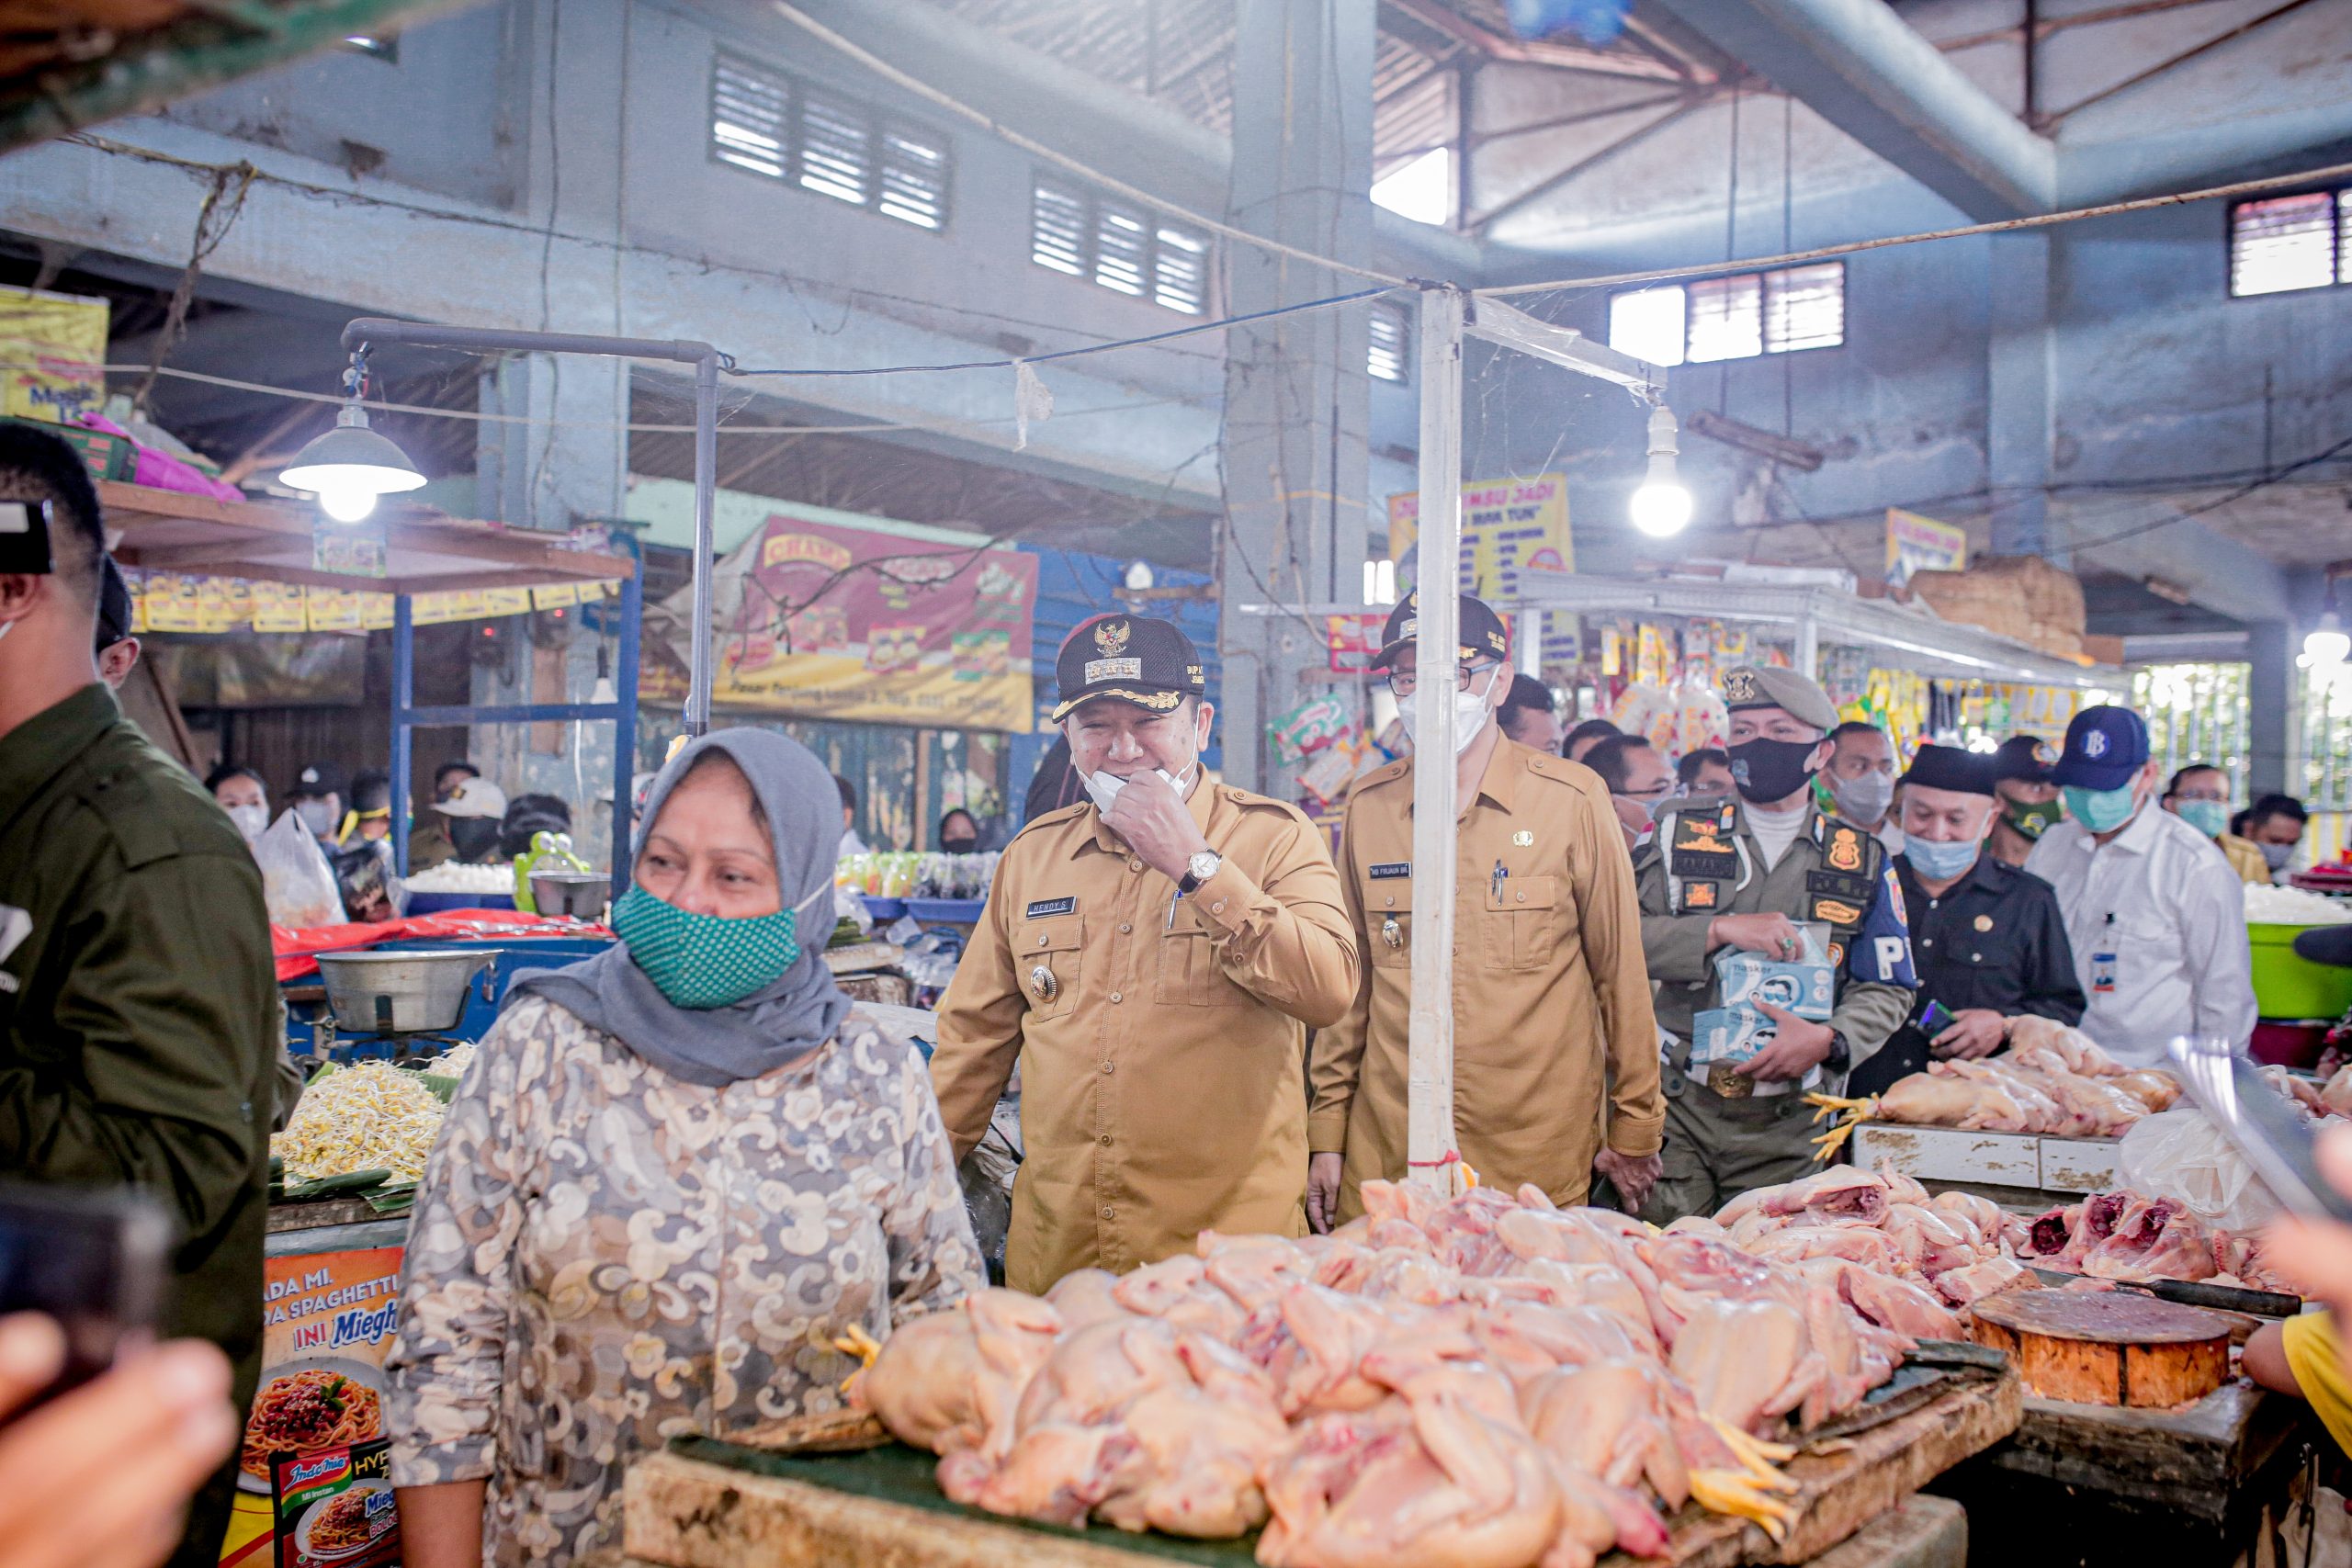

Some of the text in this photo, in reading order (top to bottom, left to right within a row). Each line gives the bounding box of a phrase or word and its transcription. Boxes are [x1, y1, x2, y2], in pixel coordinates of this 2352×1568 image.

[264, 1268, 334, 1302] DA MI.
[289, 1274, 397, 1319] SPAGHETTI
[294, 1299, 397, 1351] INI Miegh
